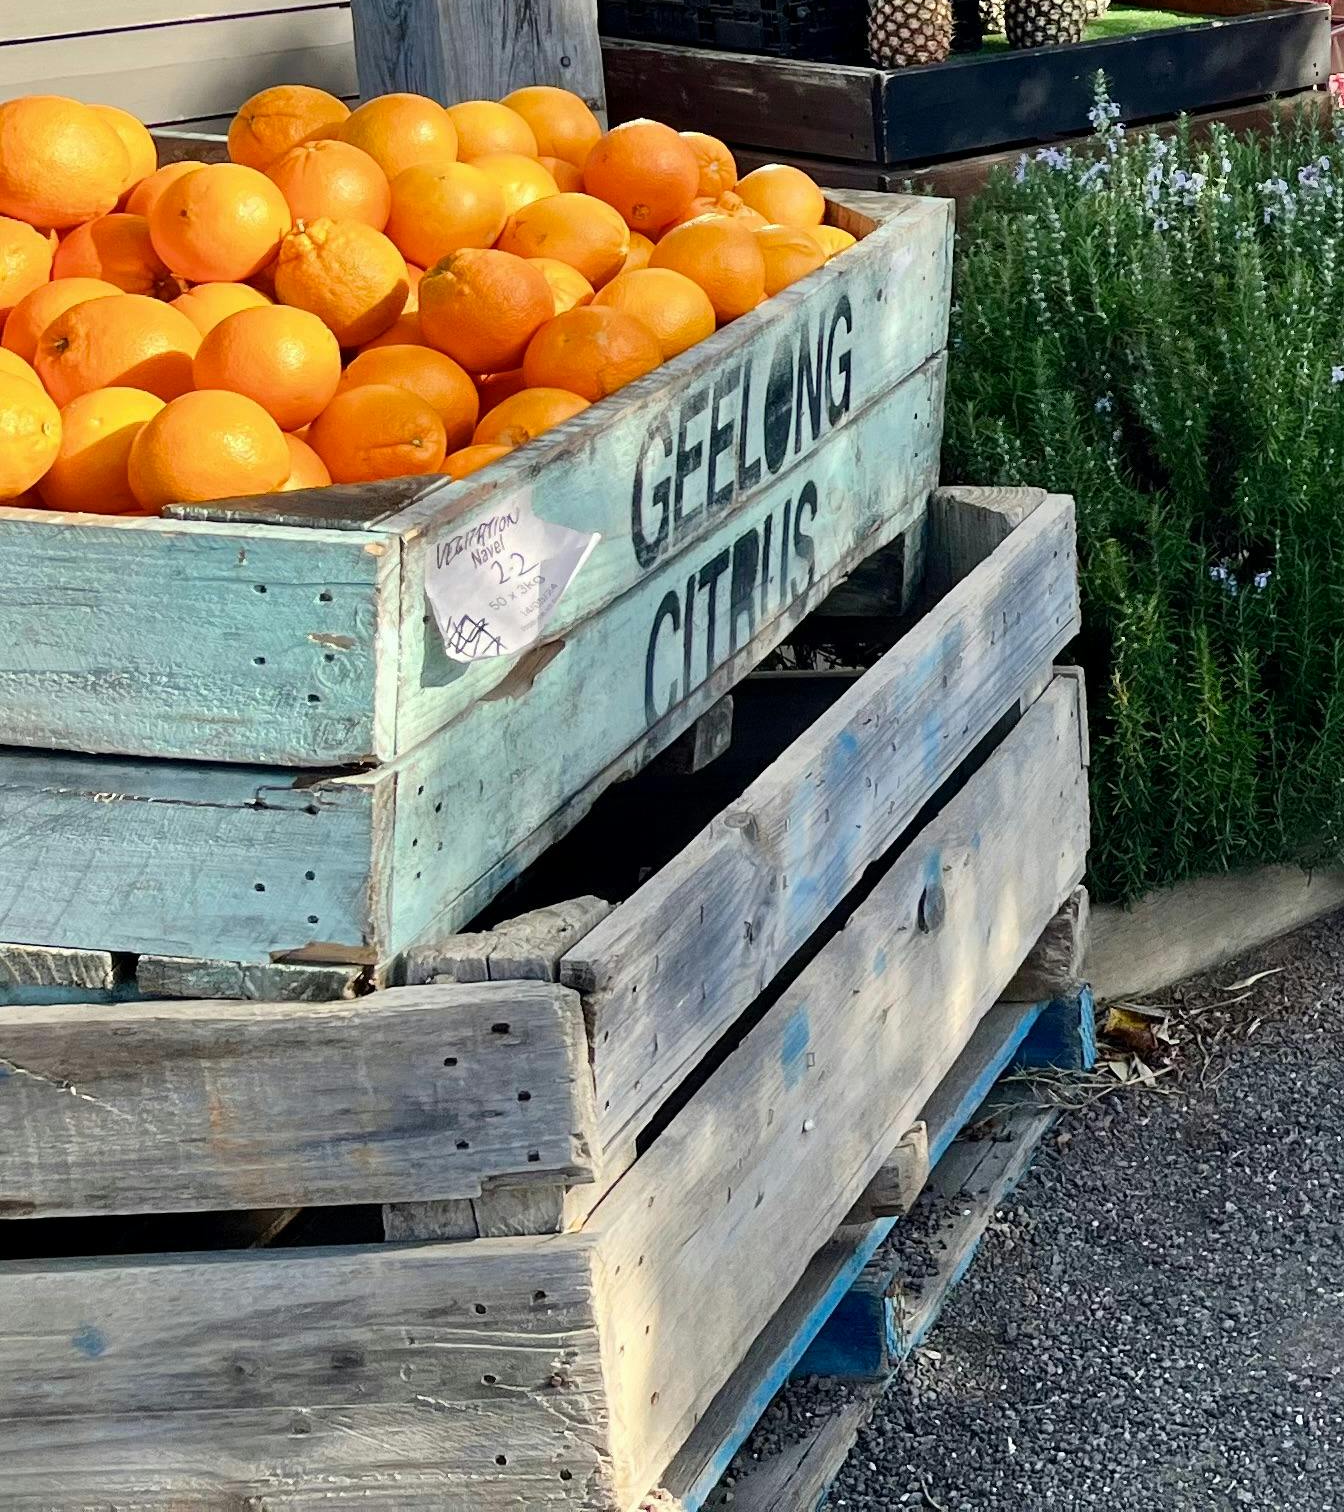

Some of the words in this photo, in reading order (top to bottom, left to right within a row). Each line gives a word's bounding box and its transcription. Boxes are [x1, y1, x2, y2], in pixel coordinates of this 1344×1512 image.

[631, 294, 853, 570] GEELONG
[471, 535, 505, 569] Navel
[488, 596, 508, 611] 50
[644, 479, 819, 728] CITRUS
